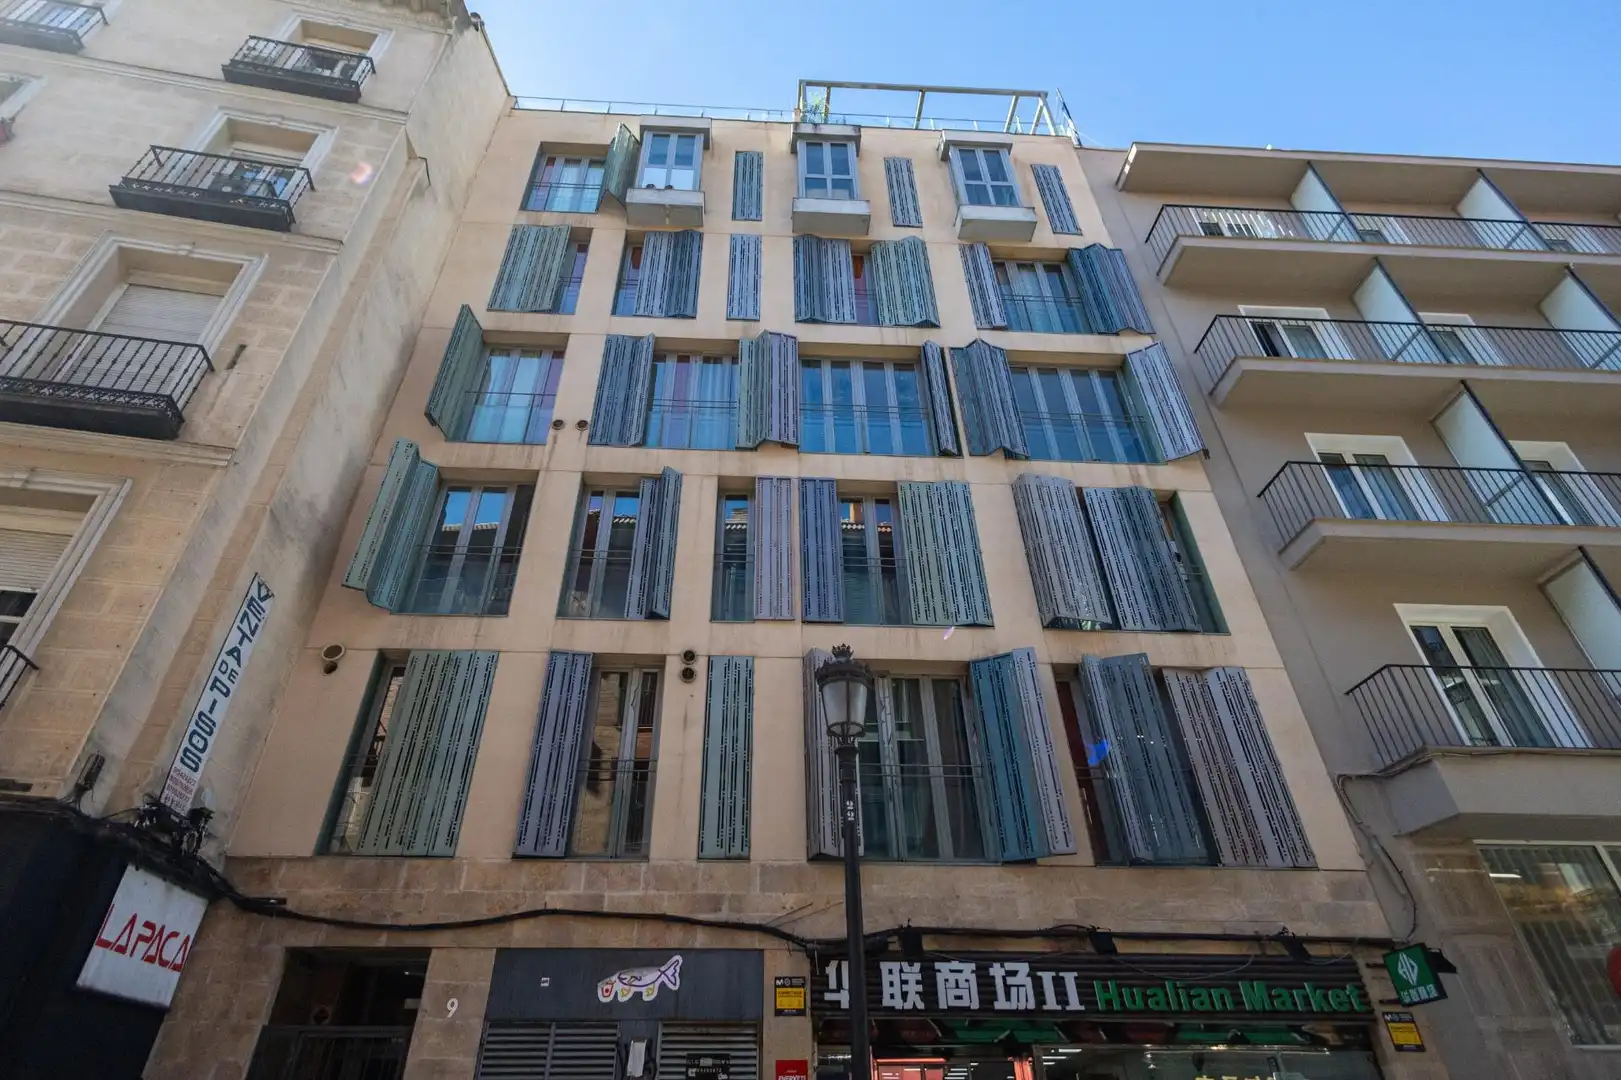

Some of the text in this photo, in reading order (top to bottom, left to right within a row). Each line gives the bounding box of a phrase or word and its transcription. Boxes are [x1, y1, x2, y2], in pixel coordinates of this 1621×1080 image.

[226, 579, 275, 668] VENTA
[218, 659, 239, 685] DE
[180, 676, 231, 773] PISOS
[446, 997, 459, 1019] 9
[1093, 979, 1366, 1013] Hualian Market
